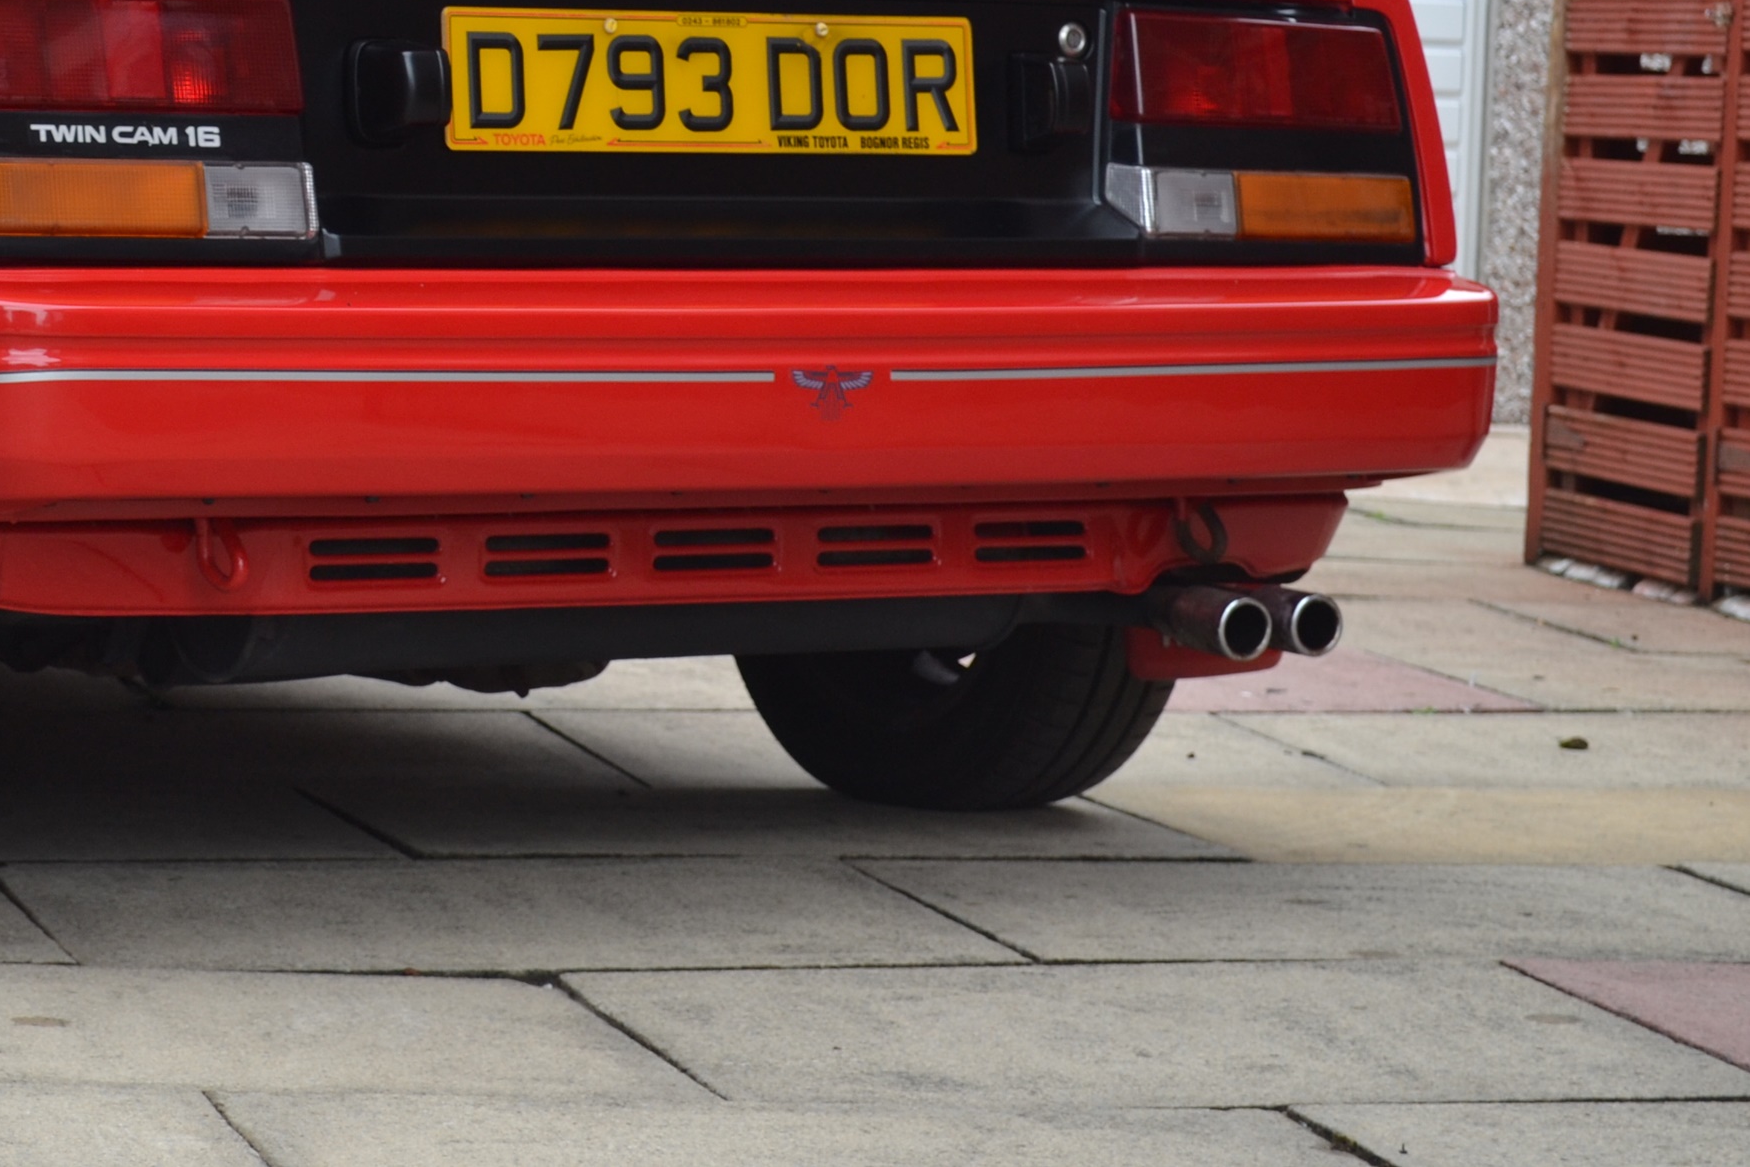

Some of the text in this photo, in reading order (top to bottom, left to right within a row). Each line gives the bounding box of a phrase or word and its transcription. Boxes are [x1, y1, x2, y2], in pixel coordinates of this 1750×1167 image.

[465, 31, 961, 133] D793 DOR
[30, 123, 222, 148] TWIN CAM 16
[493, 133, 546, 146] TOYOTA
[777, 135, 930, 150] VIKING TOYOTA BOGNOR REGIS
